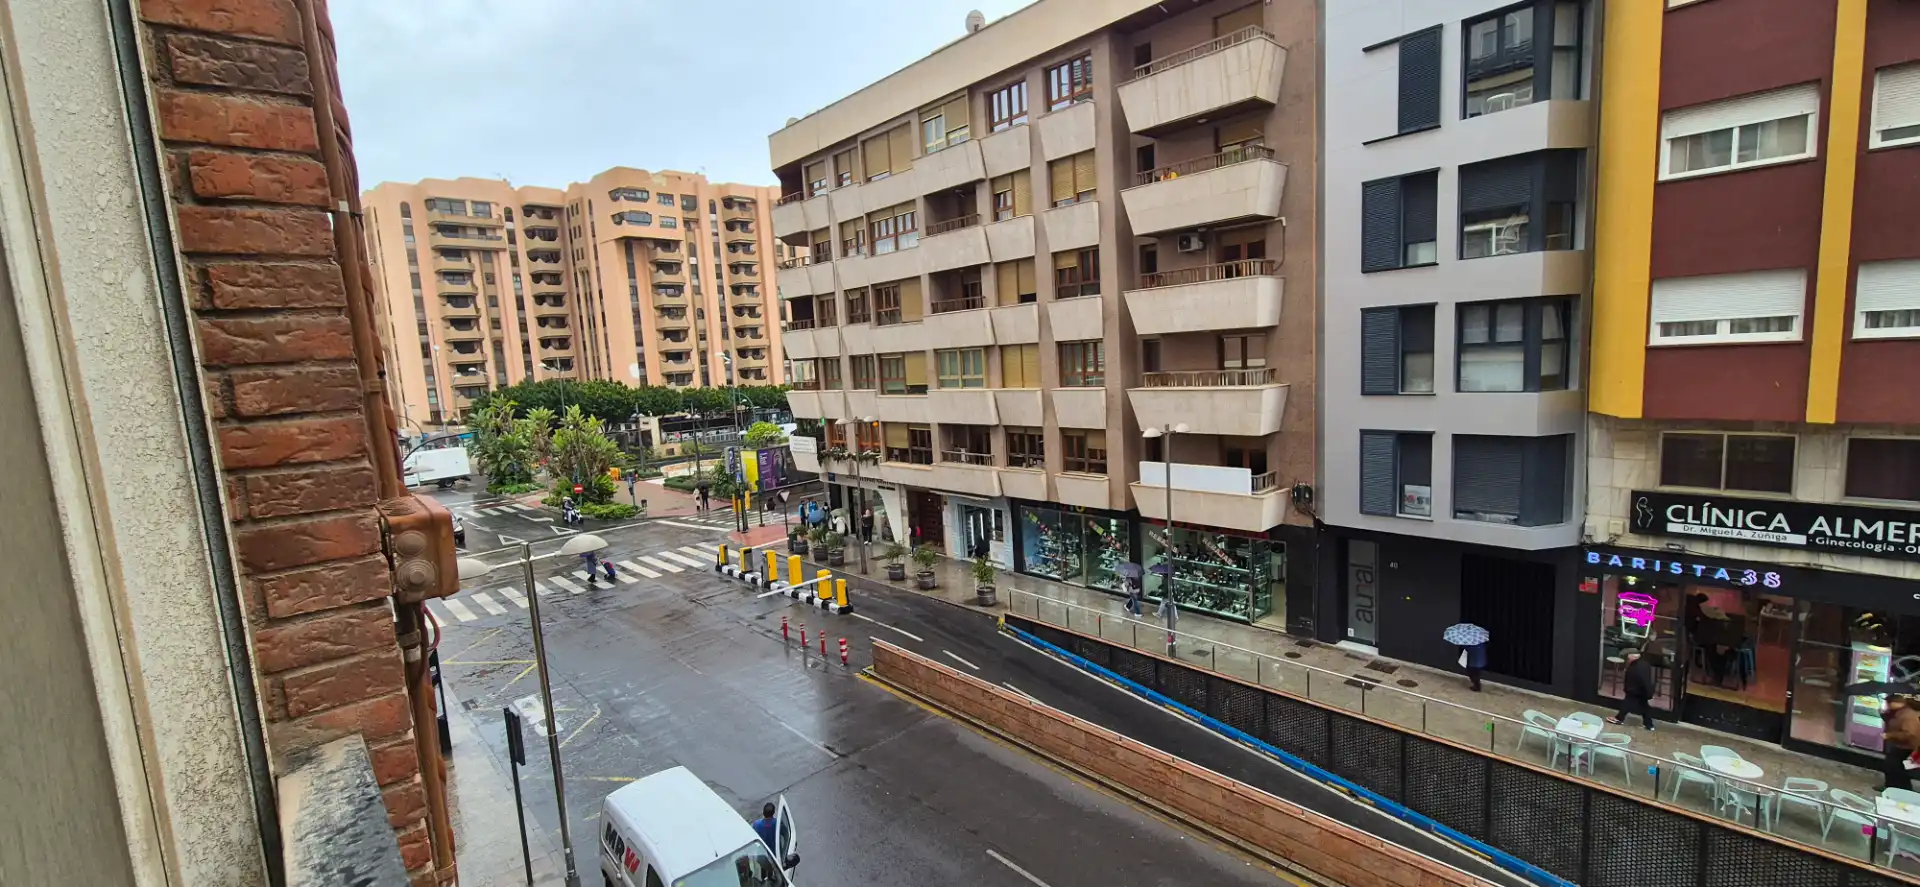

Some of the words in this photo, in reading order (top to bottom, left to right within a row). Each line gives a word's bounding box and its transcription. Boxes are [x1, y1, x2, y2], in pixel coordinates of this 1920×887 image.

[1666, 502, 1791, 533] CLÍNICA
[1808, 516, 1920, 544] ALMER
[1683, 525, 1697, 533] Dr.
[1700, 527, 1734, 538] Miguel
[1738, 530, 1748, 538] A.
[1751, 532, 1788, 542] Zúñiga
[1815, 537, 1895, 552] Ginecología
[1587, 551, 1730, 581] BARISTA
[605, 822, 640, 874] MRW
